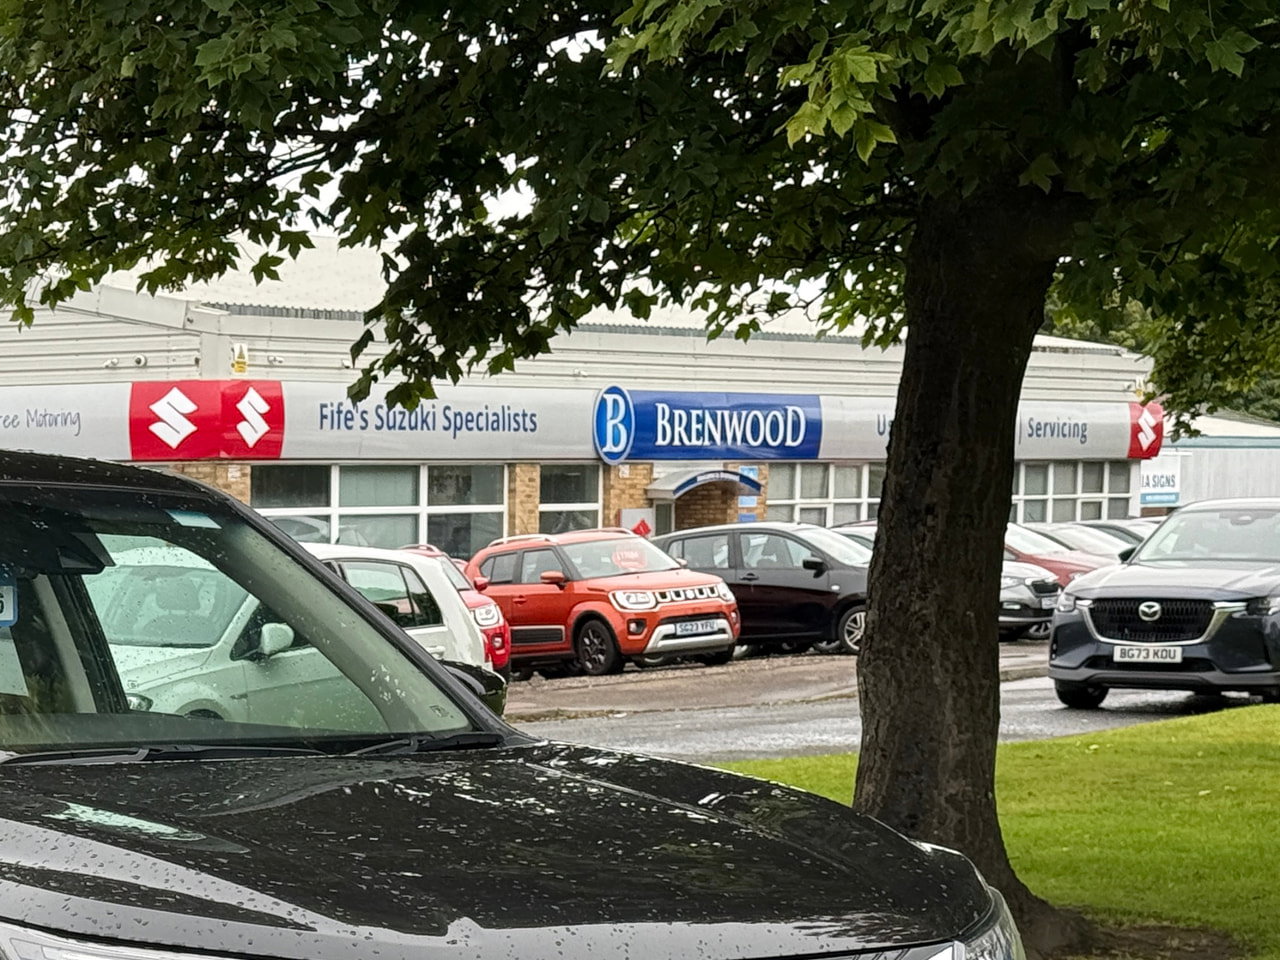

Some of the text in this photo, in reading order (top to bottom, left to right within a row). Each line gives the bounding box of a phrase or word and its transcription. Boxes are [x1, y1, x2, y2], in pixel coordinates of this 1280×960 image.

[26, 407, 82, 437] Motoring
[320, 403, 537, 439] Fife's Suzuki Specialists
[655, 403, 806, 447] BRENWOOD
[1027, 417, 1088, 444] Servicing
[1152, 474, 1175, 488] SIGNS
[1119, 648, 1151, 659] BG73
